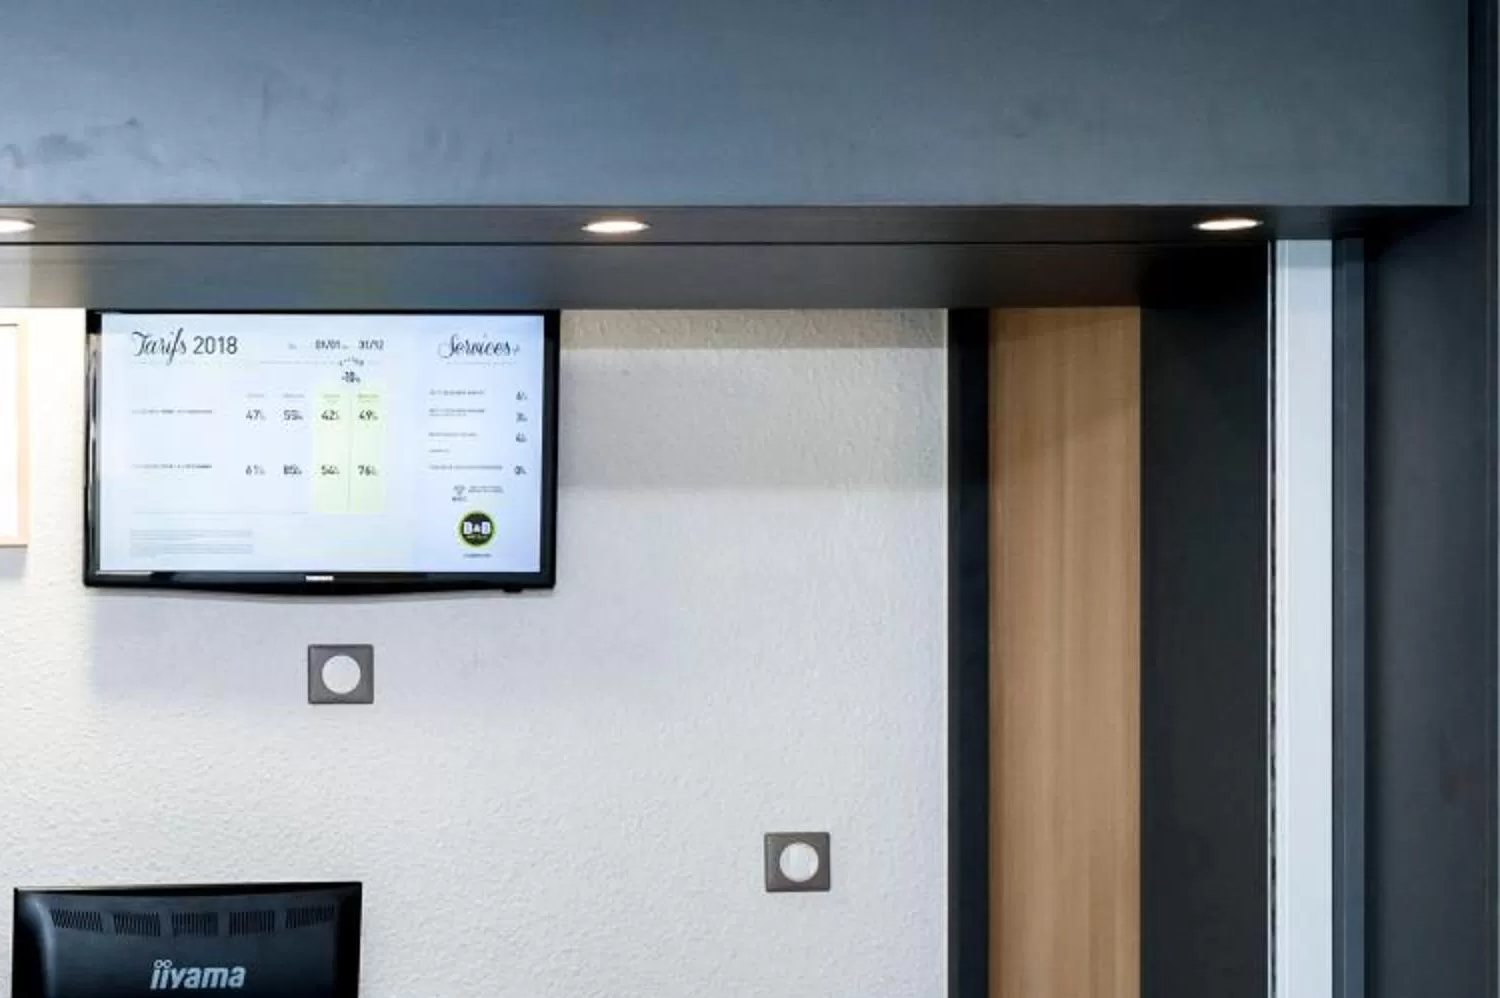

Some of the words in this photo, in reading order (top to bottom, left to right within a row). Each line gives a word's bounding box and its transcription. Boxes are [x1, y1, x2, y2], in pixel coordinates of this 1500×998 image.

[132, 328, 187, 366] Tarifs
[193, 335, 239, 355] 2018
[150, 959, 247, 991] iiyama
